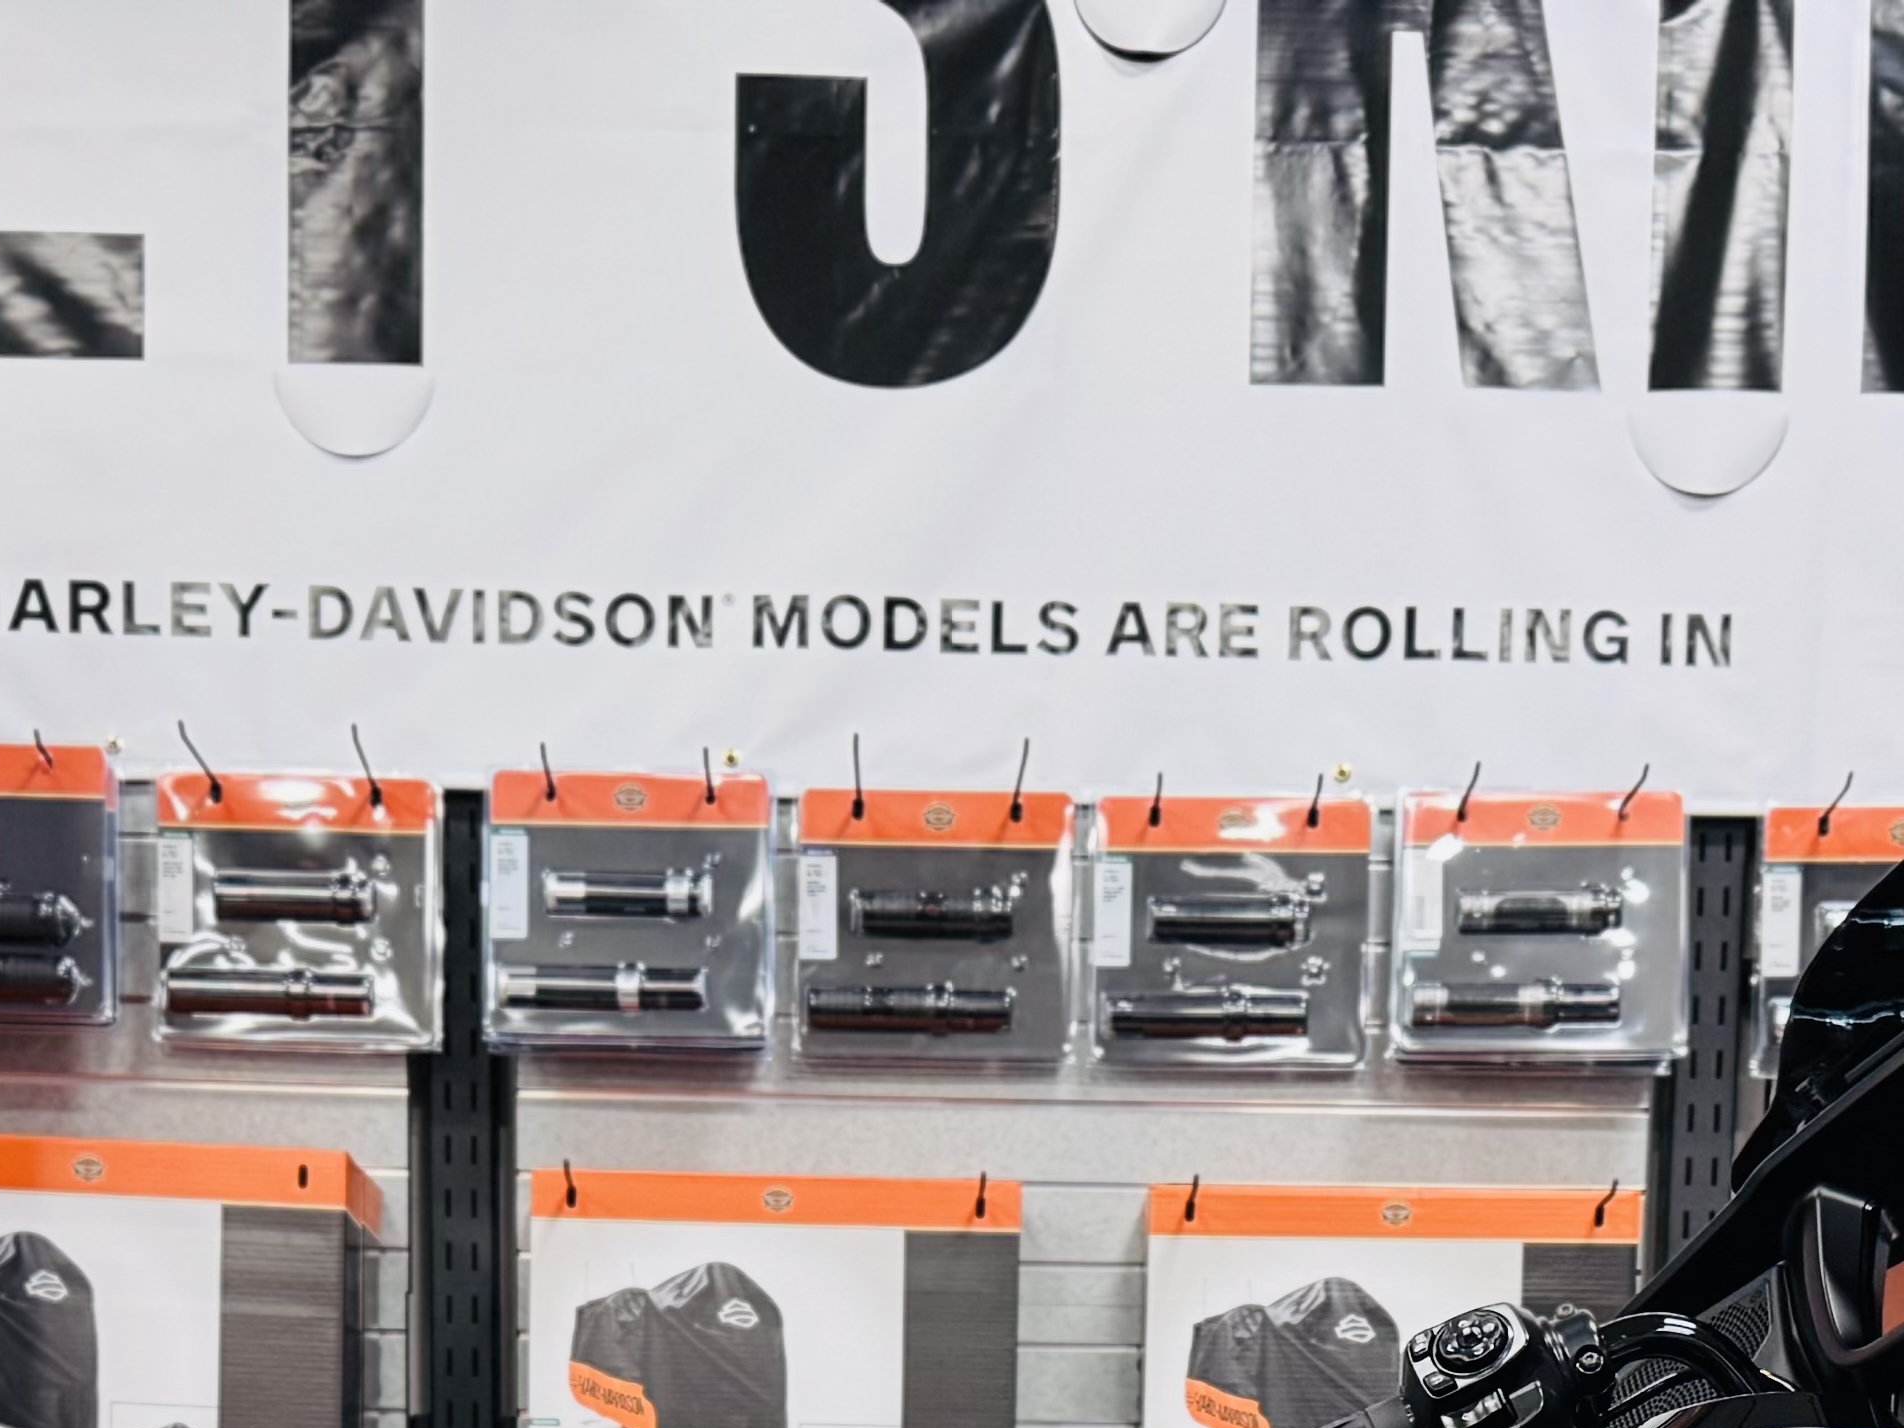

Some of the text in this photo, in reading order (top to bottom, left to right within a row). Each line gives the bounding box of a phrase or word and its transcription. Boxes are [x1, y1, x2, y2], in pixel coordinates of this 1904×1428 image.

[752, 594, 1080, 656] MODELS
[1107, 602, 1259, 658] ARE
[1289, 605, 1630, 664] ROLLING
[1659, 612, 1734, 667] IN
